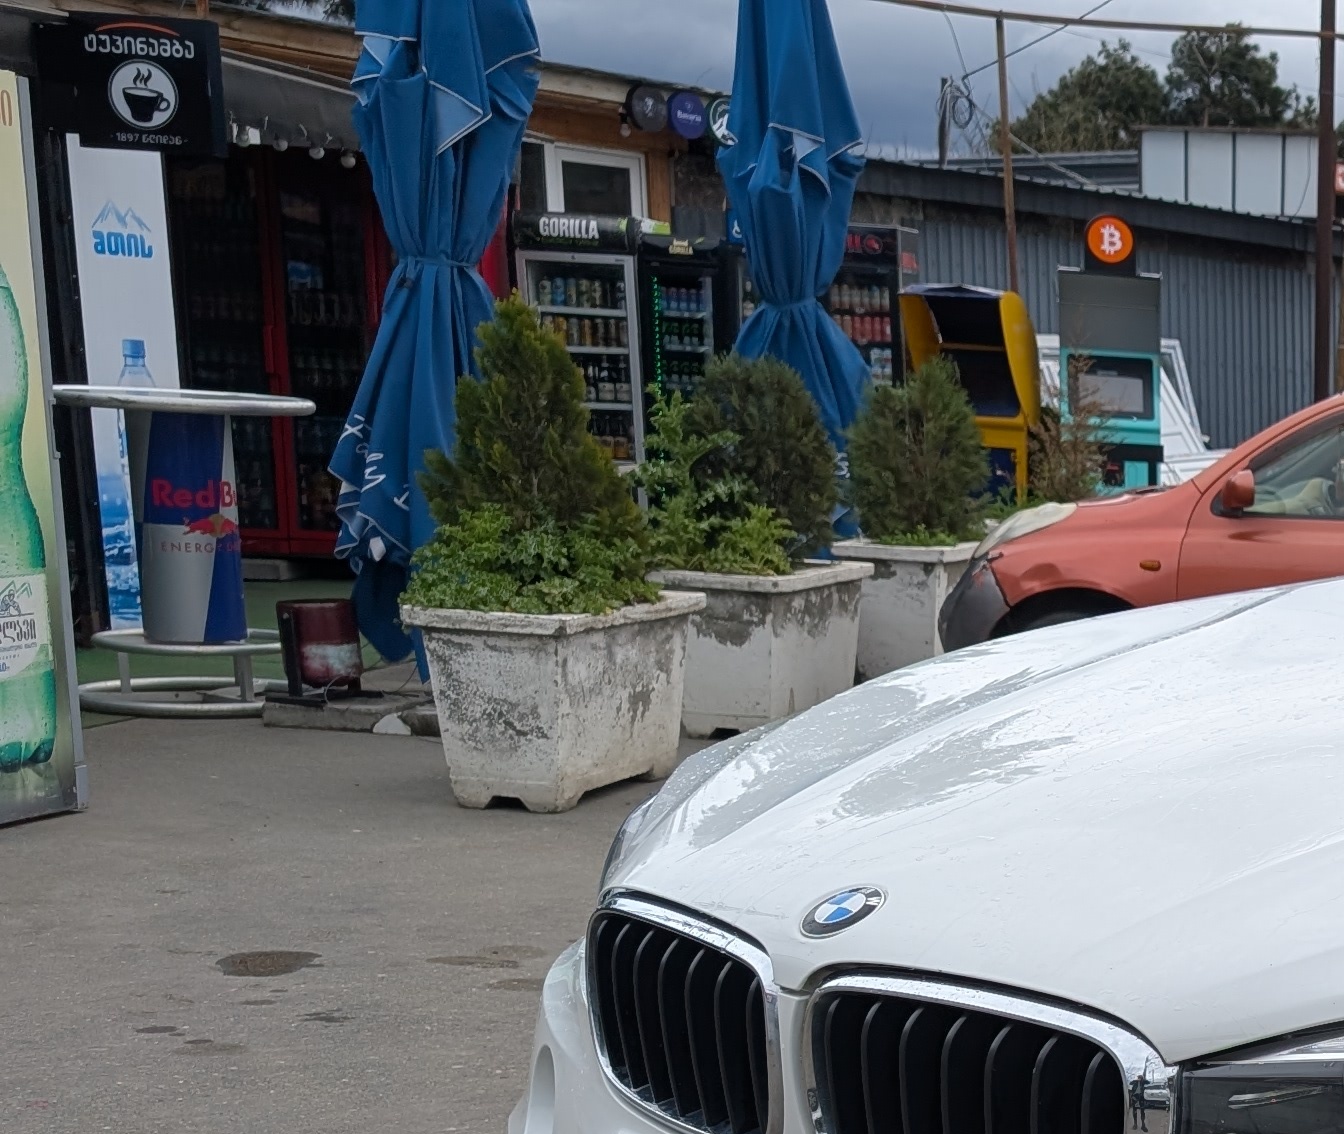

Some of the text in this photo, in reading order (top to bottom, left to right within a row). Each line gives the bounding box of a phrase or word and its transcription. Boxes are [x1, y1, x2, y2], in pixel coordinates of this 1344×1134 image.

[115, 132, 139, 142] 1897
[538, 216, 600, 240] GORILLA
[152, 478, 216, 508] Red
[0, 618, 37, 644] ლავი
